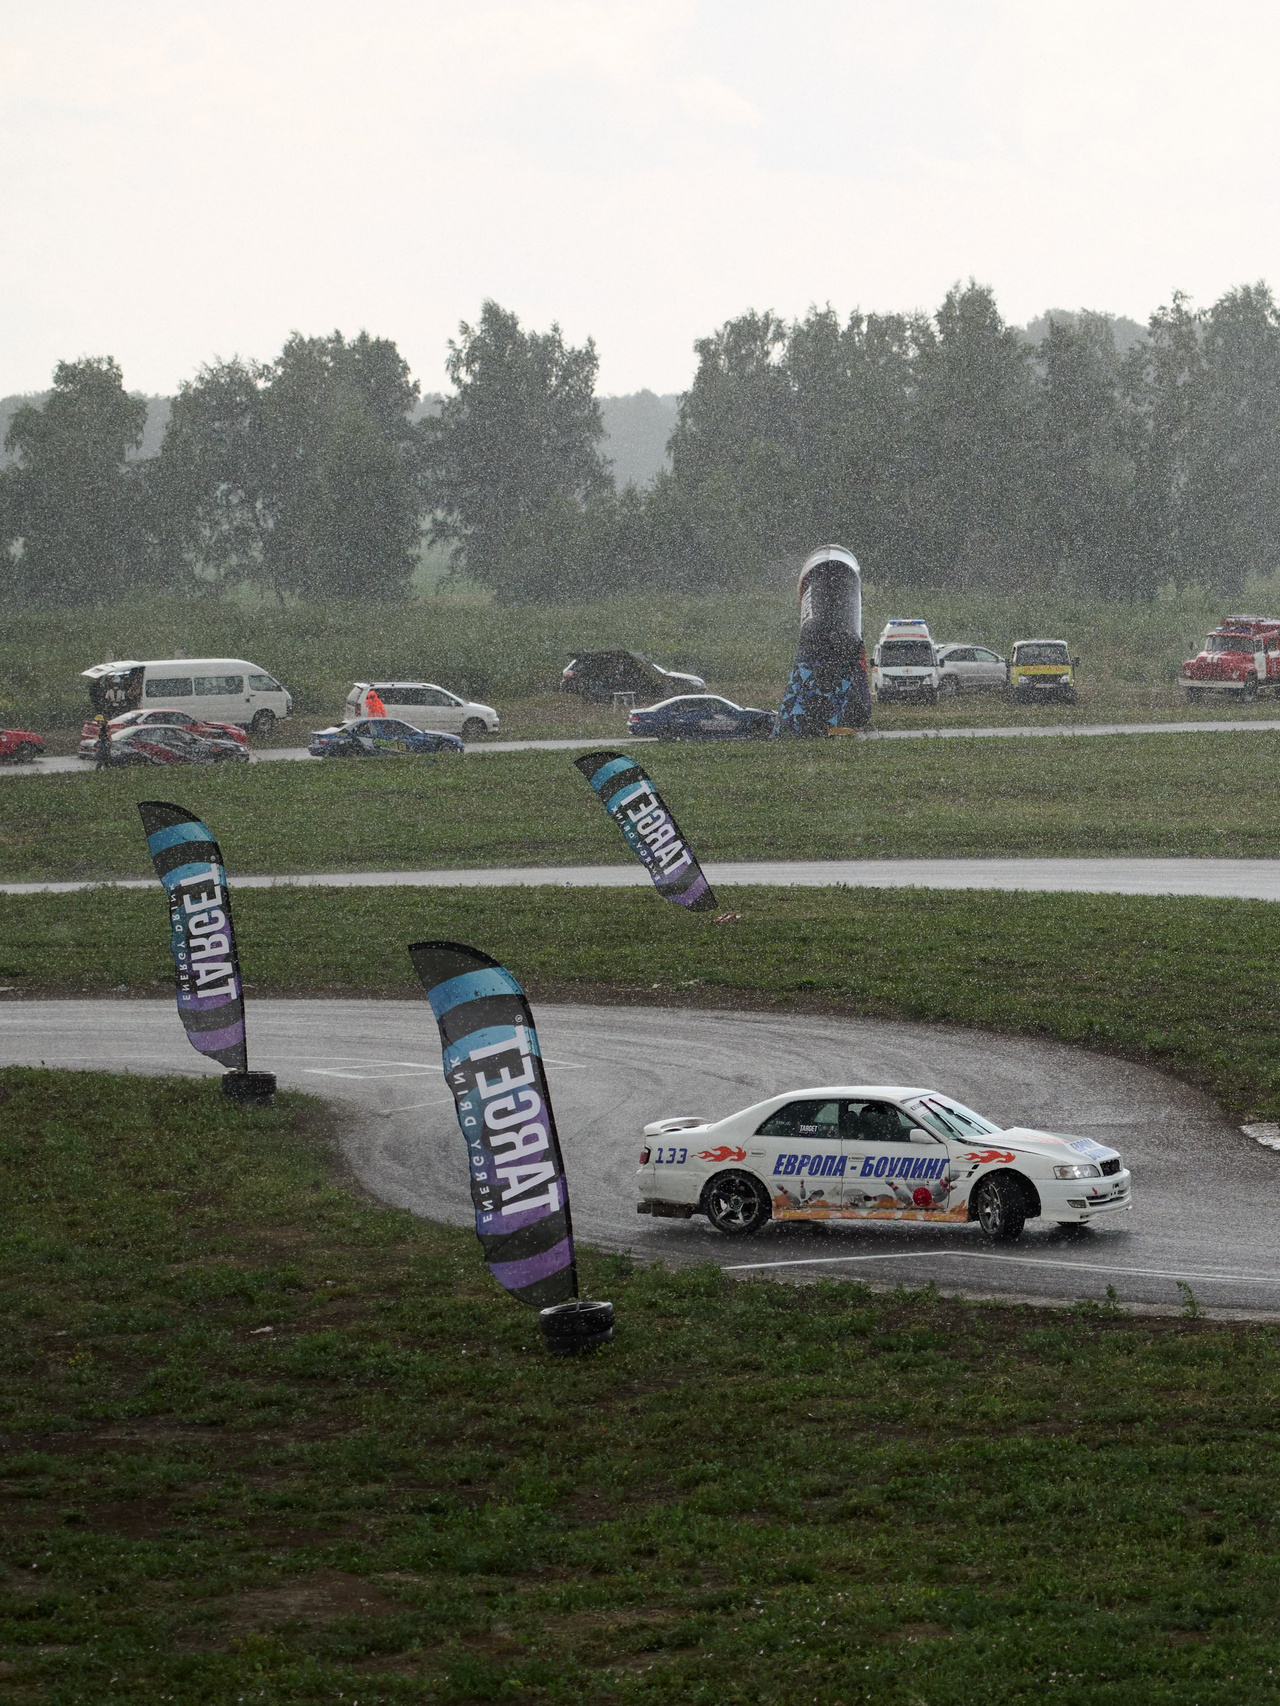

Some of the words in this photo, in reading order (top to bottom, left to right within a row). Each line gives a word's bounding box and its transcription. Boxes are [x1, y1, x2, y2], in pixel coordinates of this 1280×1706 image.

[655, 1147, 688, 1164] 133
[773, 1153, 848, 1177] ЕВРОПА
[860, 1156, 950, 1180] БОУЛИНГ
